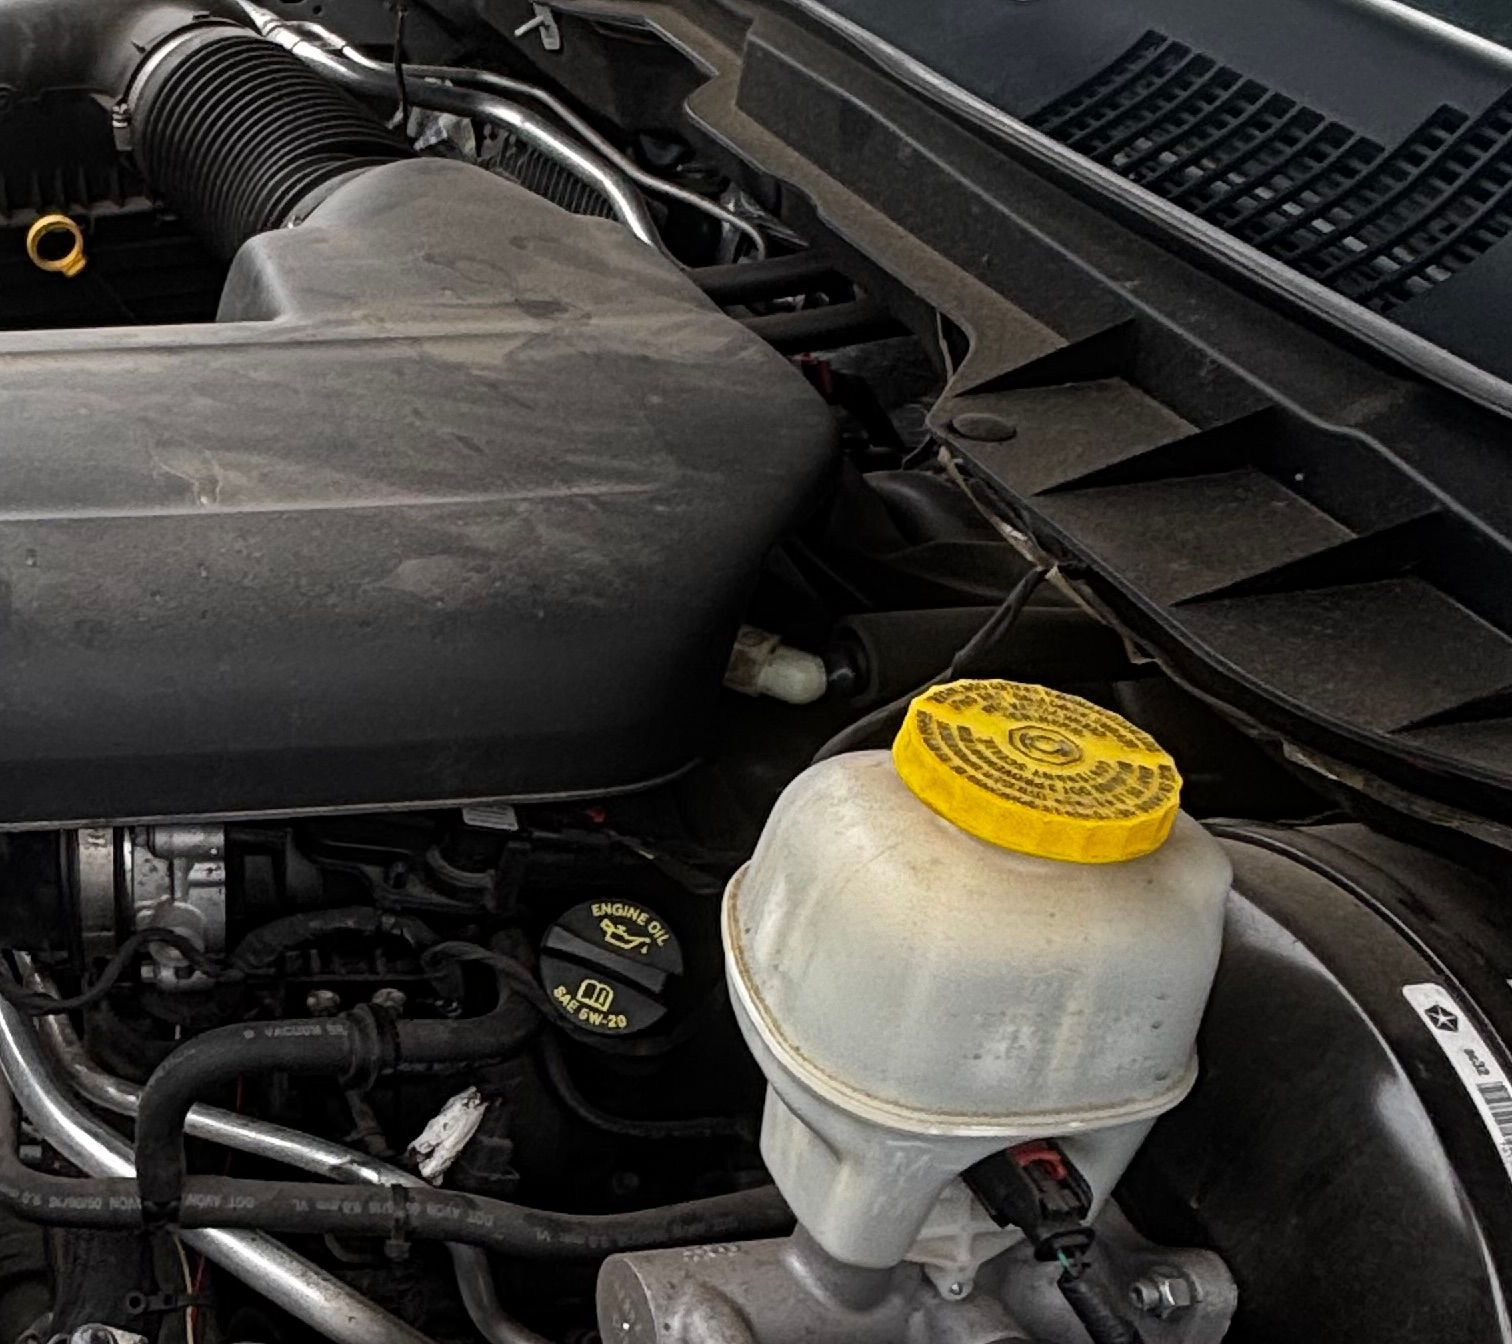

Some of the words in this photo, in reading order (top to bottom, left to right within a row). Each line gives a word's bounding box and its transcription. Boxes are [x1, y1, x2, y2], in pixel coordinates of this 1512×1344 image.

[590, 902, 650, 926] ENGINE
[647, 920, 670, 947] OIL
[553, 985, 581, 1014] SAE
[578, 1008, 628, 1028] 5W-20
